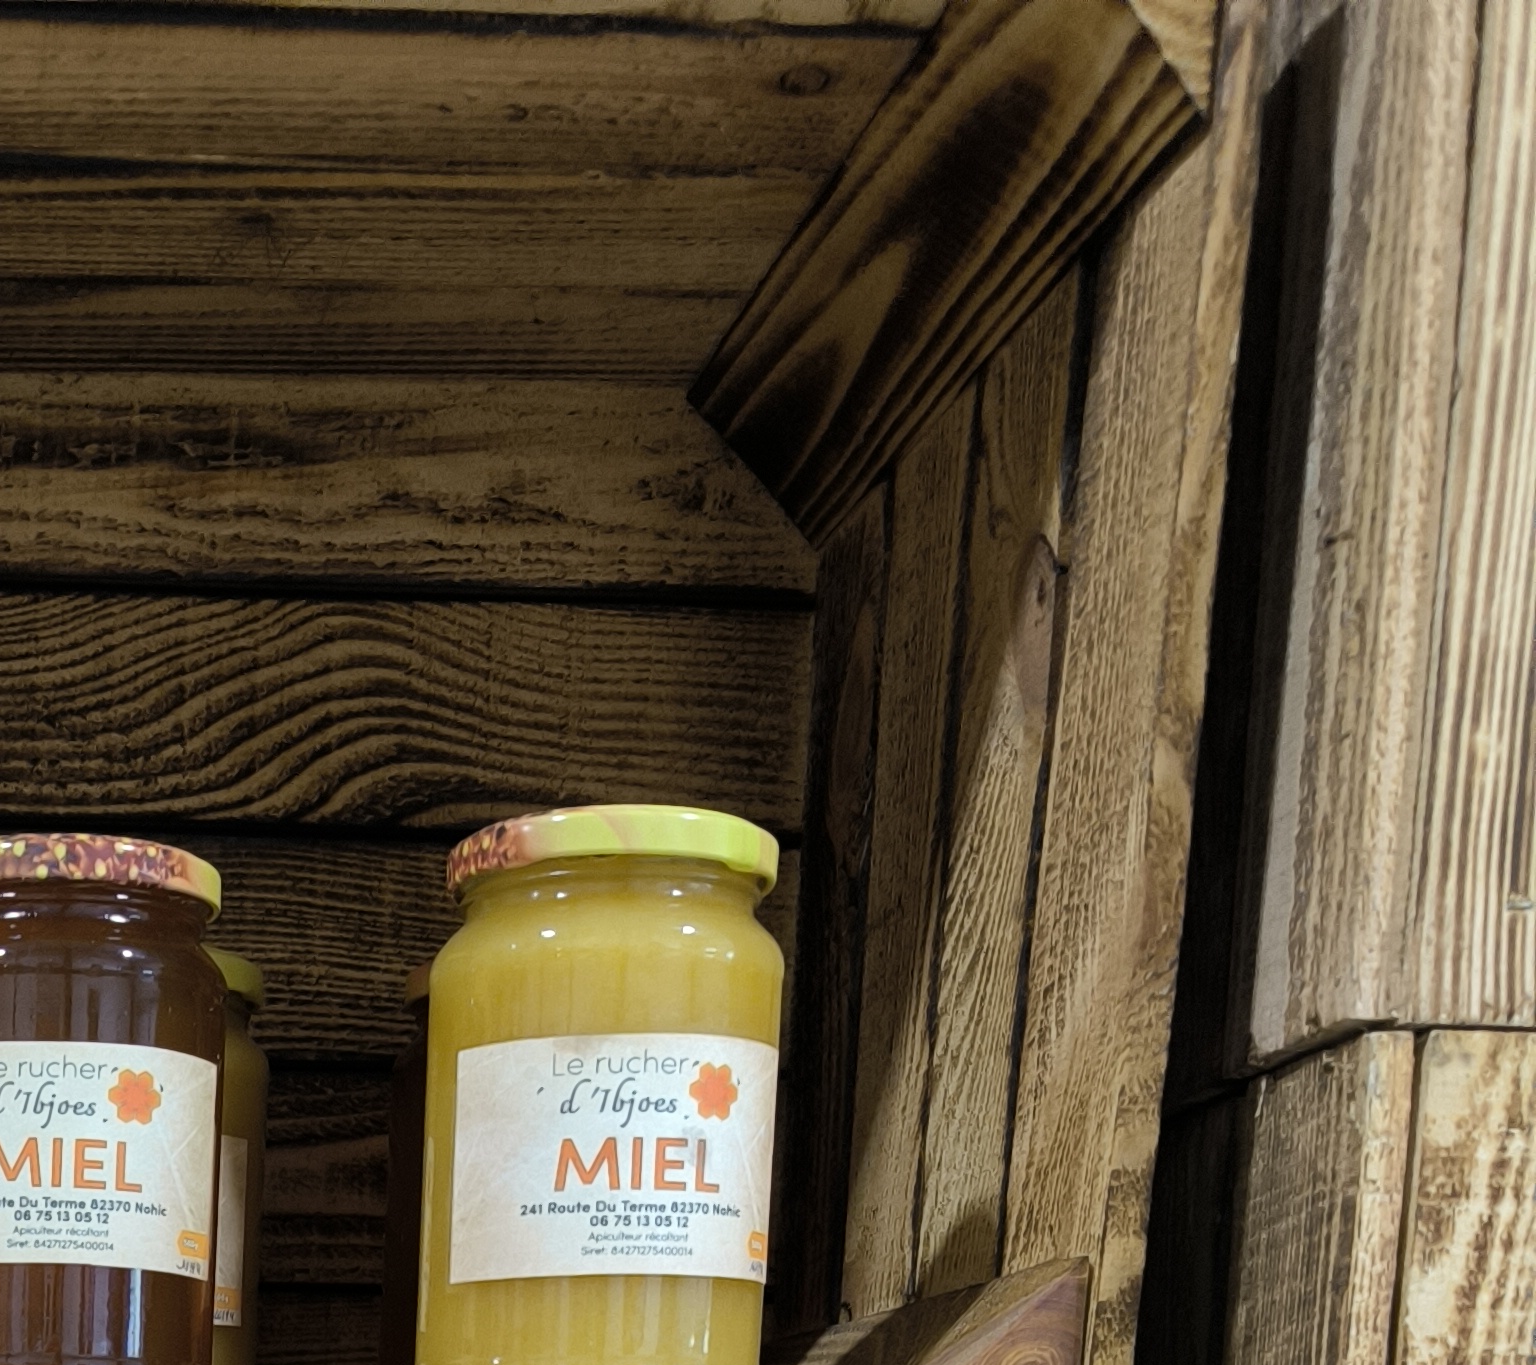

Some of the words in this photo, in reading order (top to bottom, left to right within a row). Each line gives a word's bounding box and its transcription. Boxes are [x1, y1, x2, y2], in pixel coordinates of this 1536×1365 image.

[18, 1055, 108, 1081] rucher
[552, 1053, 583, 1077] Le
[595, 1049, 689, 1075] rucher
[554, 1137, 720, 1193] MIEL
[14, 1210, 31, 1221] 06
[35, 1210, 52, 1221] 75
[56, 1211, 70, 1222] 13
[75, 1211, 92, 1223] 05
[96, 1213, 109, 1224] 12
[19, 1196, 38, 1208] Du
[42, 1196, 86, 1209] Terme
[90, 1199, 131, 1213] 82370
[135, 1202, 167, 1217] Nohic
[520, 1204, 543, 1216] 241
[548, 1201, 591, 1214] Route
[595, 1200, 616, 1213] Du
[621, 1200, 666, 1213] Terme
[670, 1201, 710, 1215] 82370
[589, 1215, 608, 1227] 06
[614, 1215, 631, 1227] 75
[636, 1215, 650, 1227] 13
[654, 1215, 672, 1227] 05
[676, 1216, 689, 1228] 12
